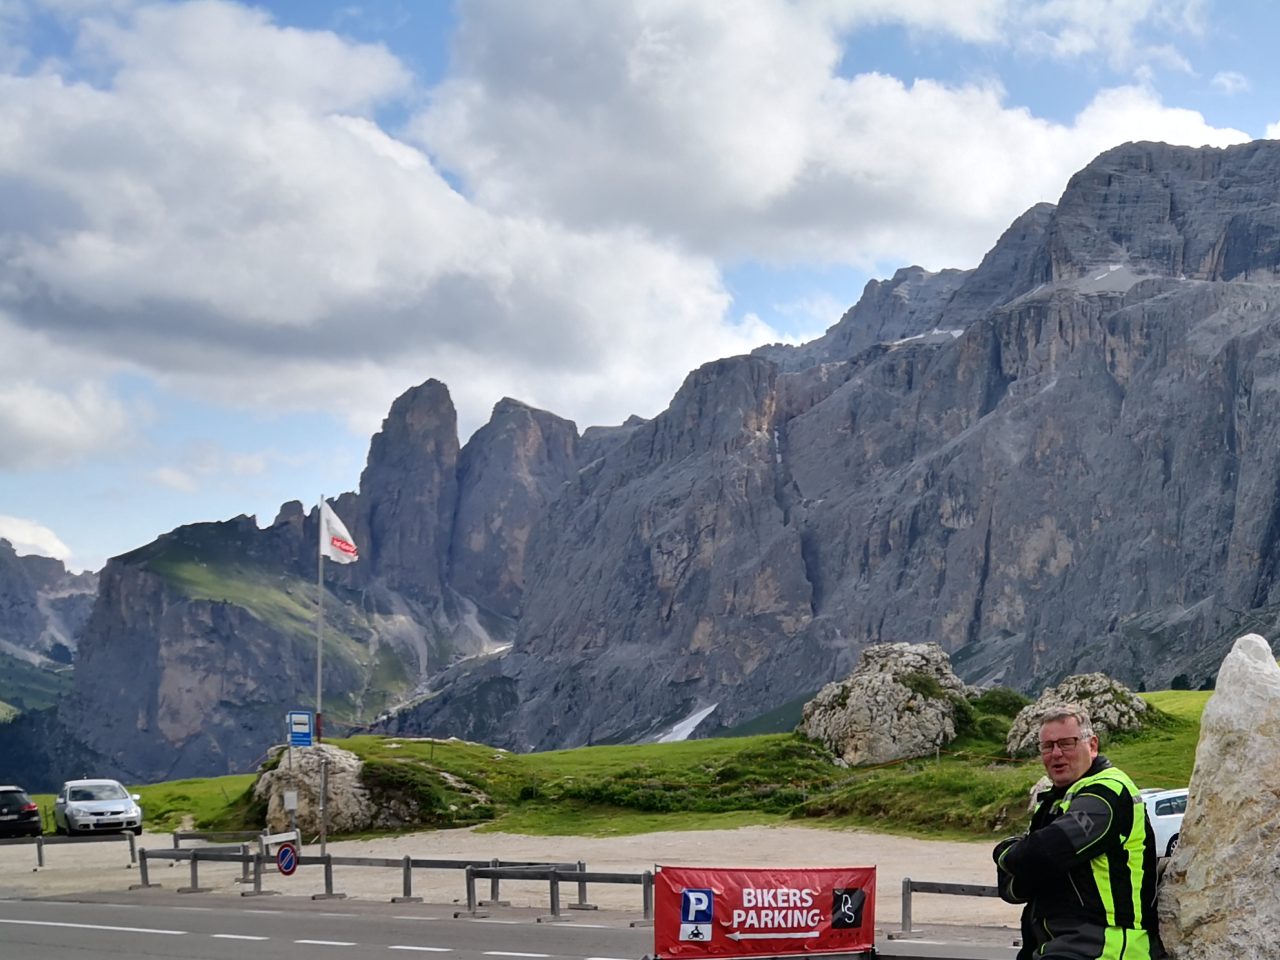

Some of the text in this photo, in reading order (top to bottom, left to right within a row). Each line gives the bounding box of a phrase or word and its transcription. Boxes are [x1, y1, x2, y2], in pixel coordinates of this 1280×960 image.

[688, 893, 709, 921] P
[743, 888, 813, 907] BIKERS
[732, 909, 820, 928] PARKING
